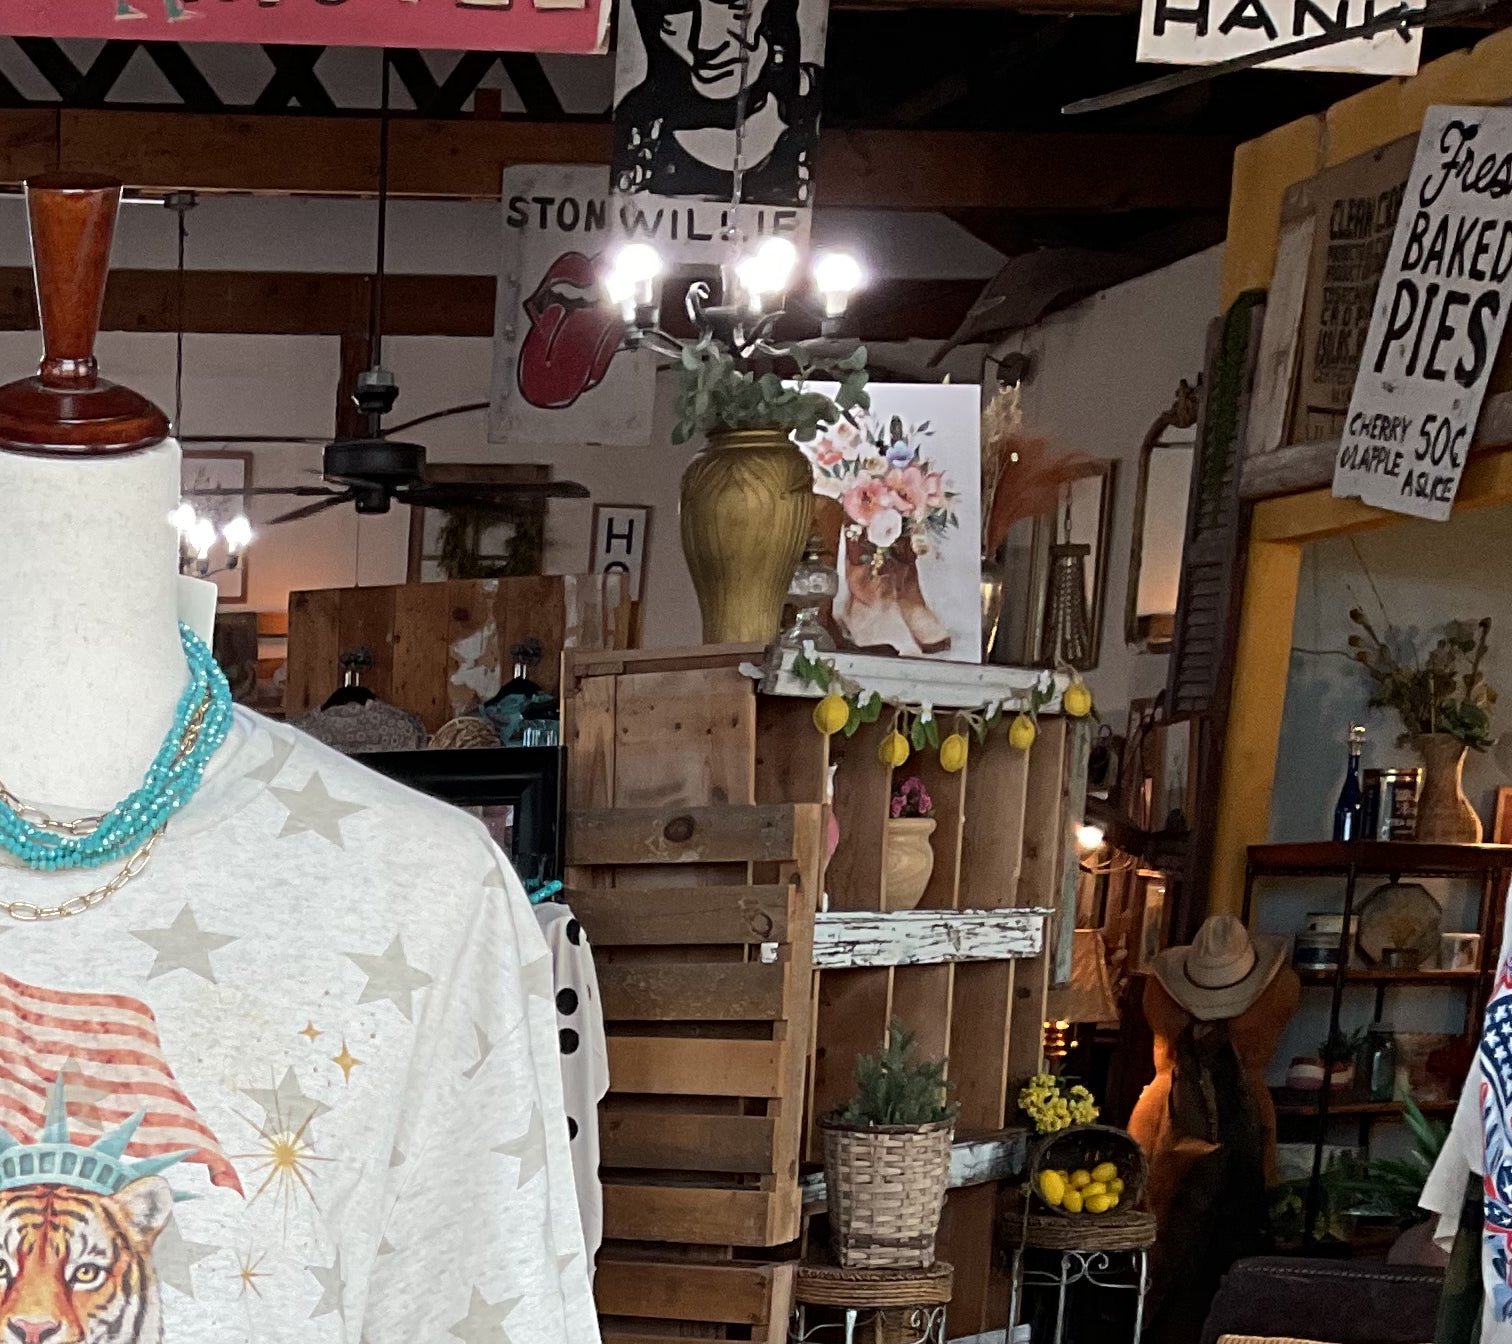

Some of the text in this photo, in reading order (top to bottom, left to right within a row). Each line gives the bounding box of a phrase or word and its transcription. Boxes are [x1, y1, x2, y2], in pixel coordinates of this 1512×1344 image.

[1400, 210, 1512, 284] BAKED
[1373, 278, 1501, 389] PIES
[1350, 411, 1413, 443] CHERRY
